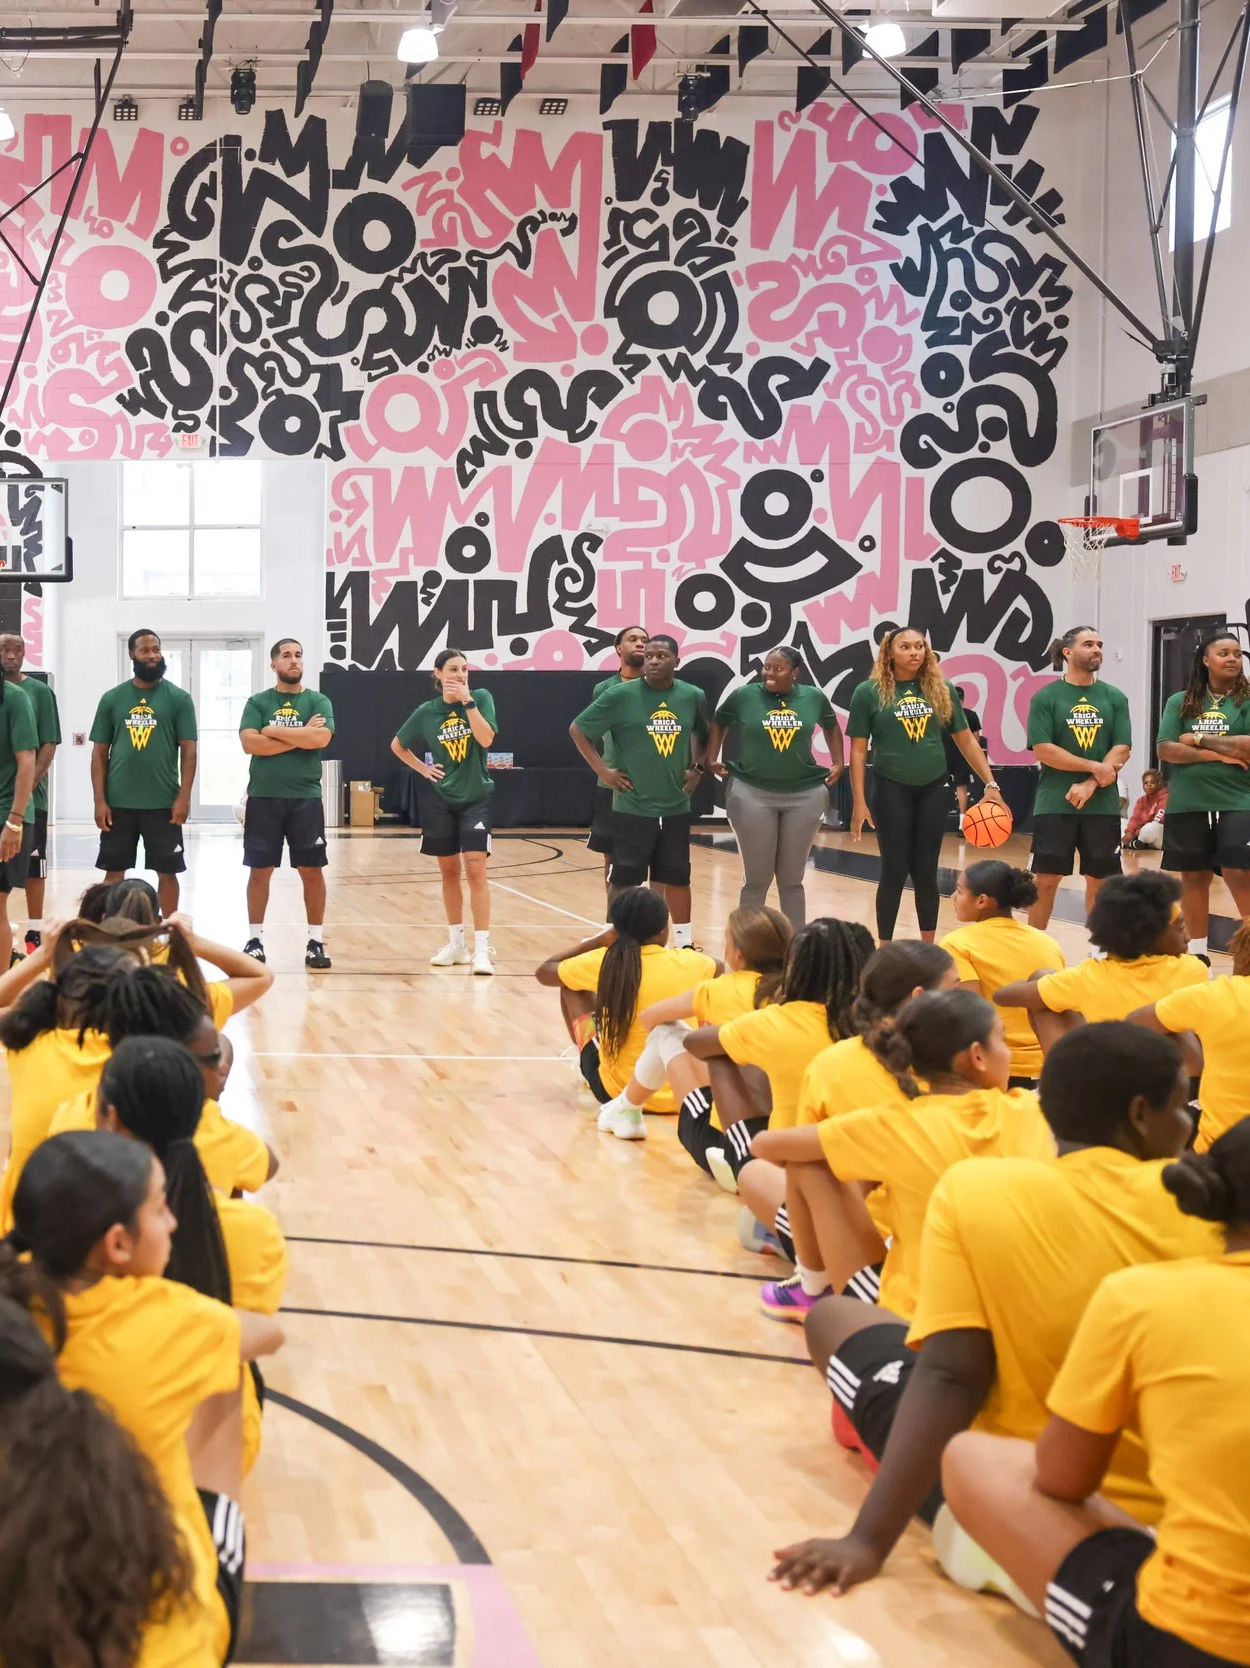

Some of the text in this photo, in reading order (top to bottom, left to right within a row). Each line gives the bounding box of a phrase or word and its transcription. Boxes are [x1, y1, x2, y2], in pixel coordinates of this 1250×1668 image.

[182, 434, 198, 447] EXIT
[893, 708, 933, 717] WHEELER
[442, 724, 465, 734] ERICA
